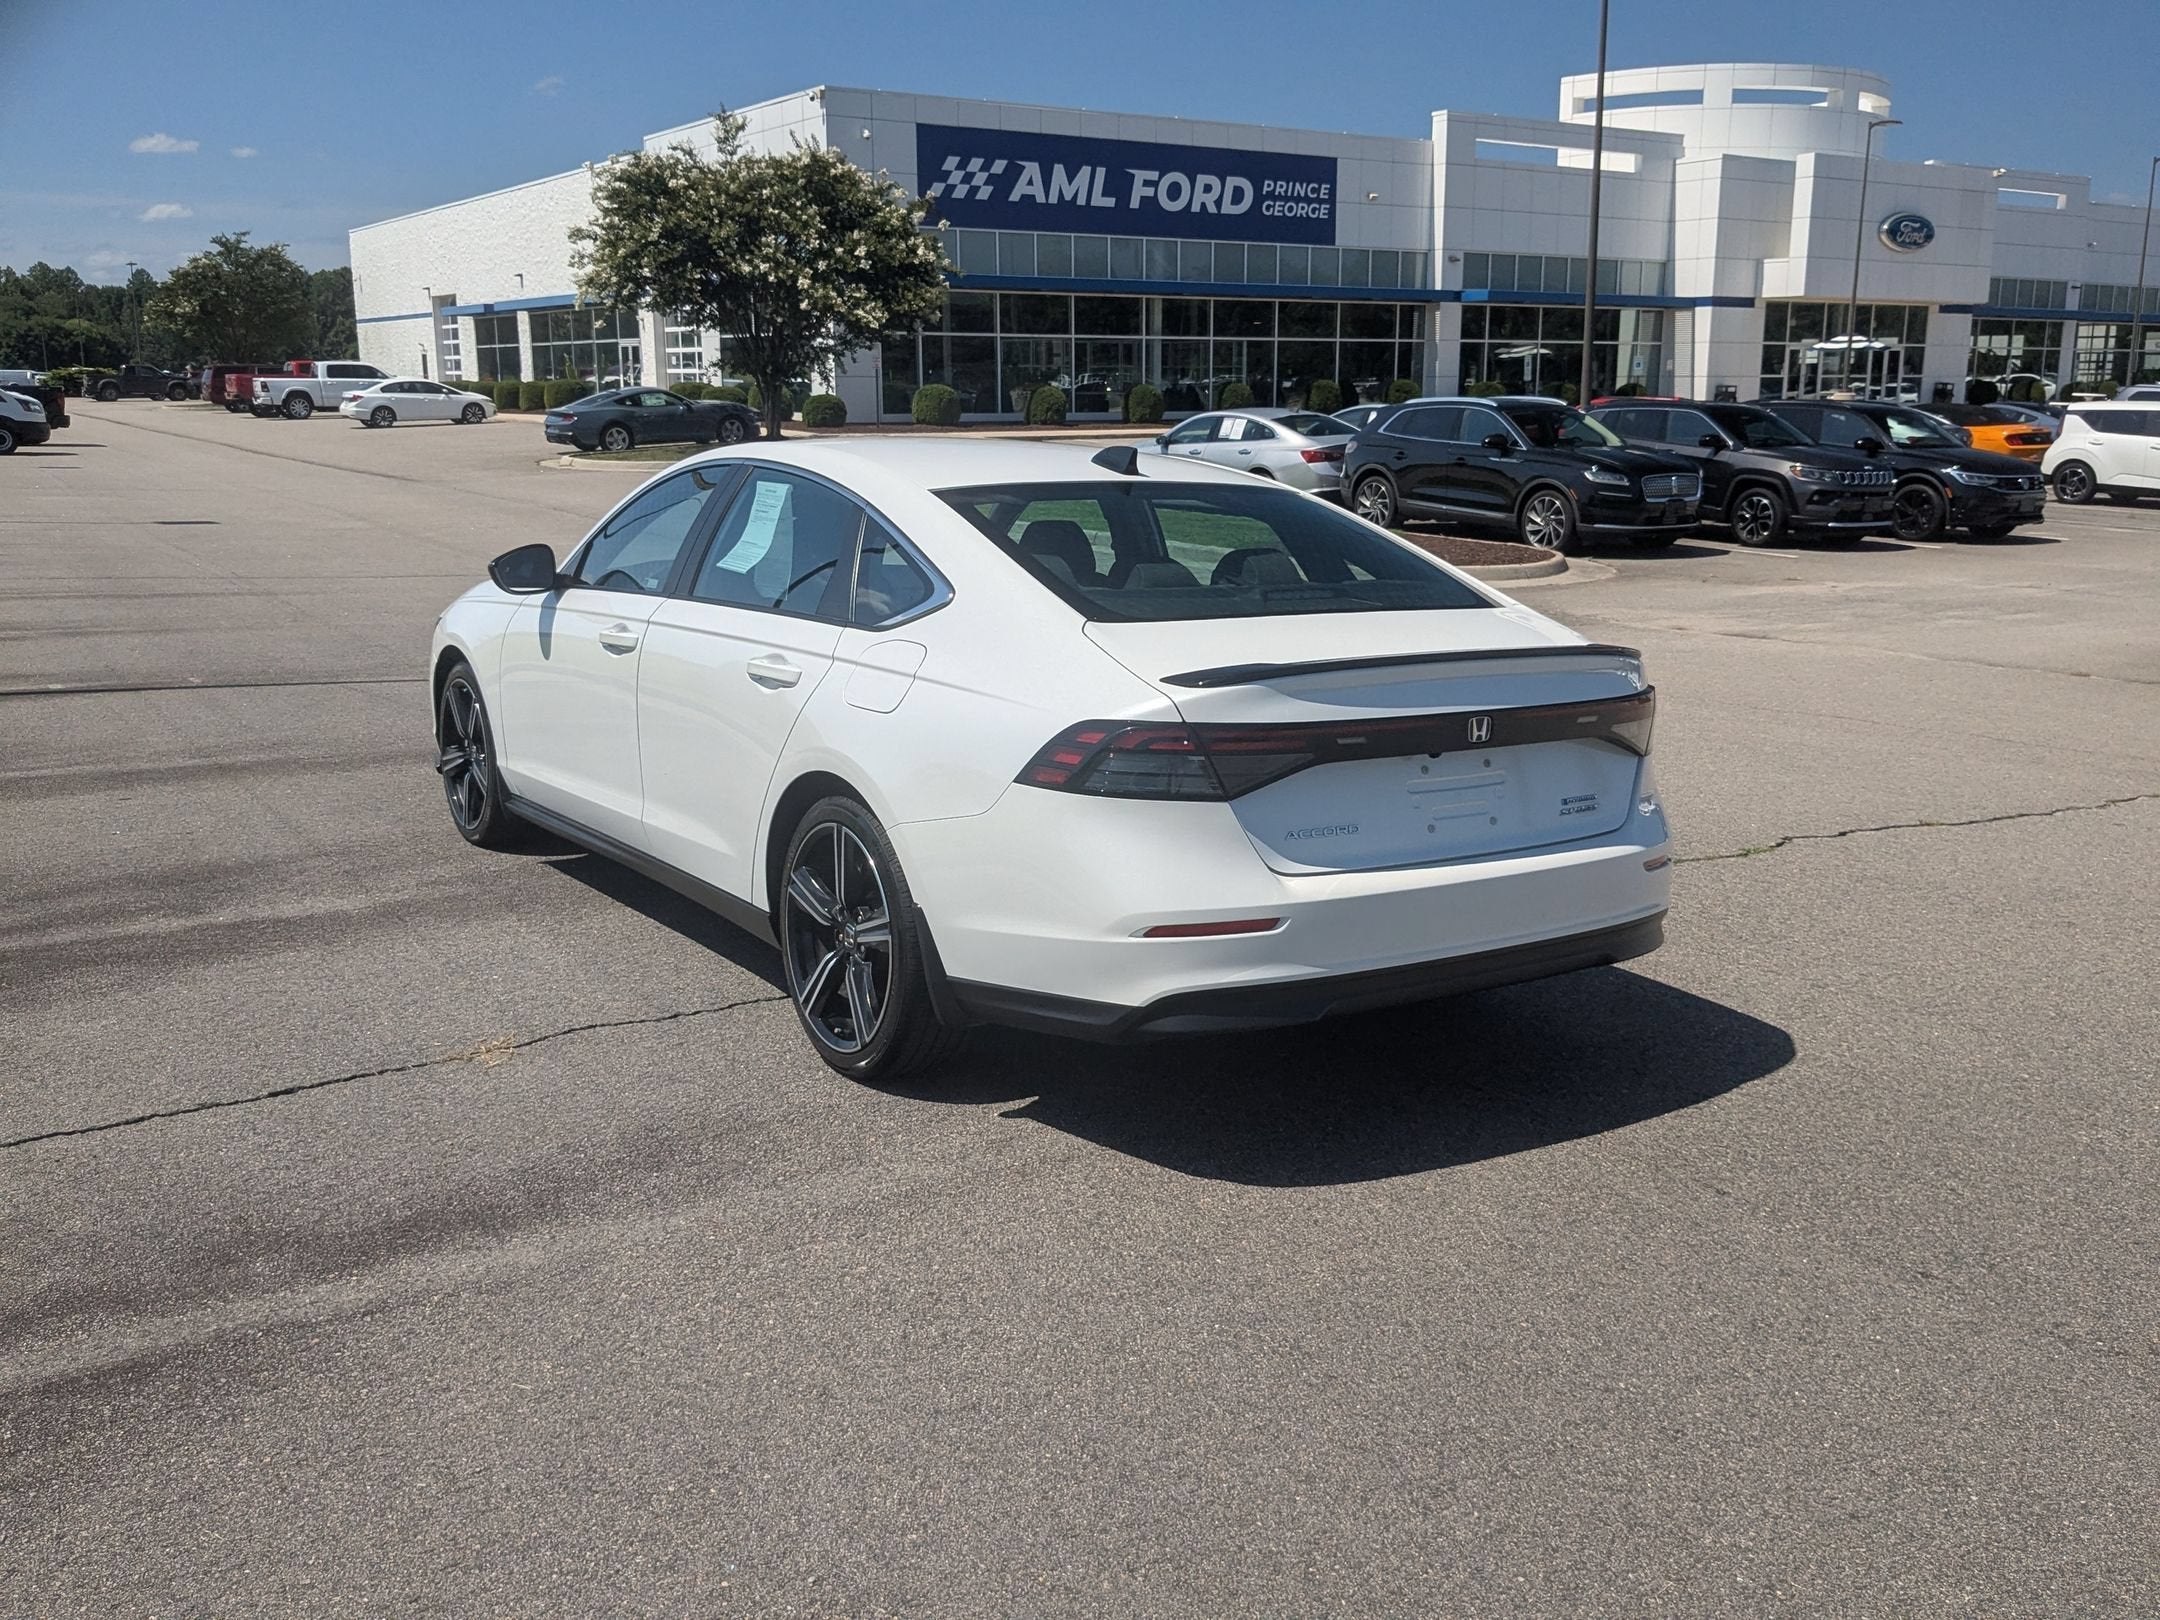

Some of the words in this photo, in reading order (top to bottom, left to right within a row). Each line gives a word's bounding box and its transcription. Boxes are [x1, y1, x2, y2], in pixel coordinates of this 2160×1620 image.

[1007, 160, 1117, 208] AML
[1123, 168, 1254, 215] FORD
[1262, 179, 1330, 199] PRINCE
[1262, 200, 1330, 219] GEORGE
[1896, 221, 1927, 243] Ford
[1284, 824, 1360, 841] ACCORD
